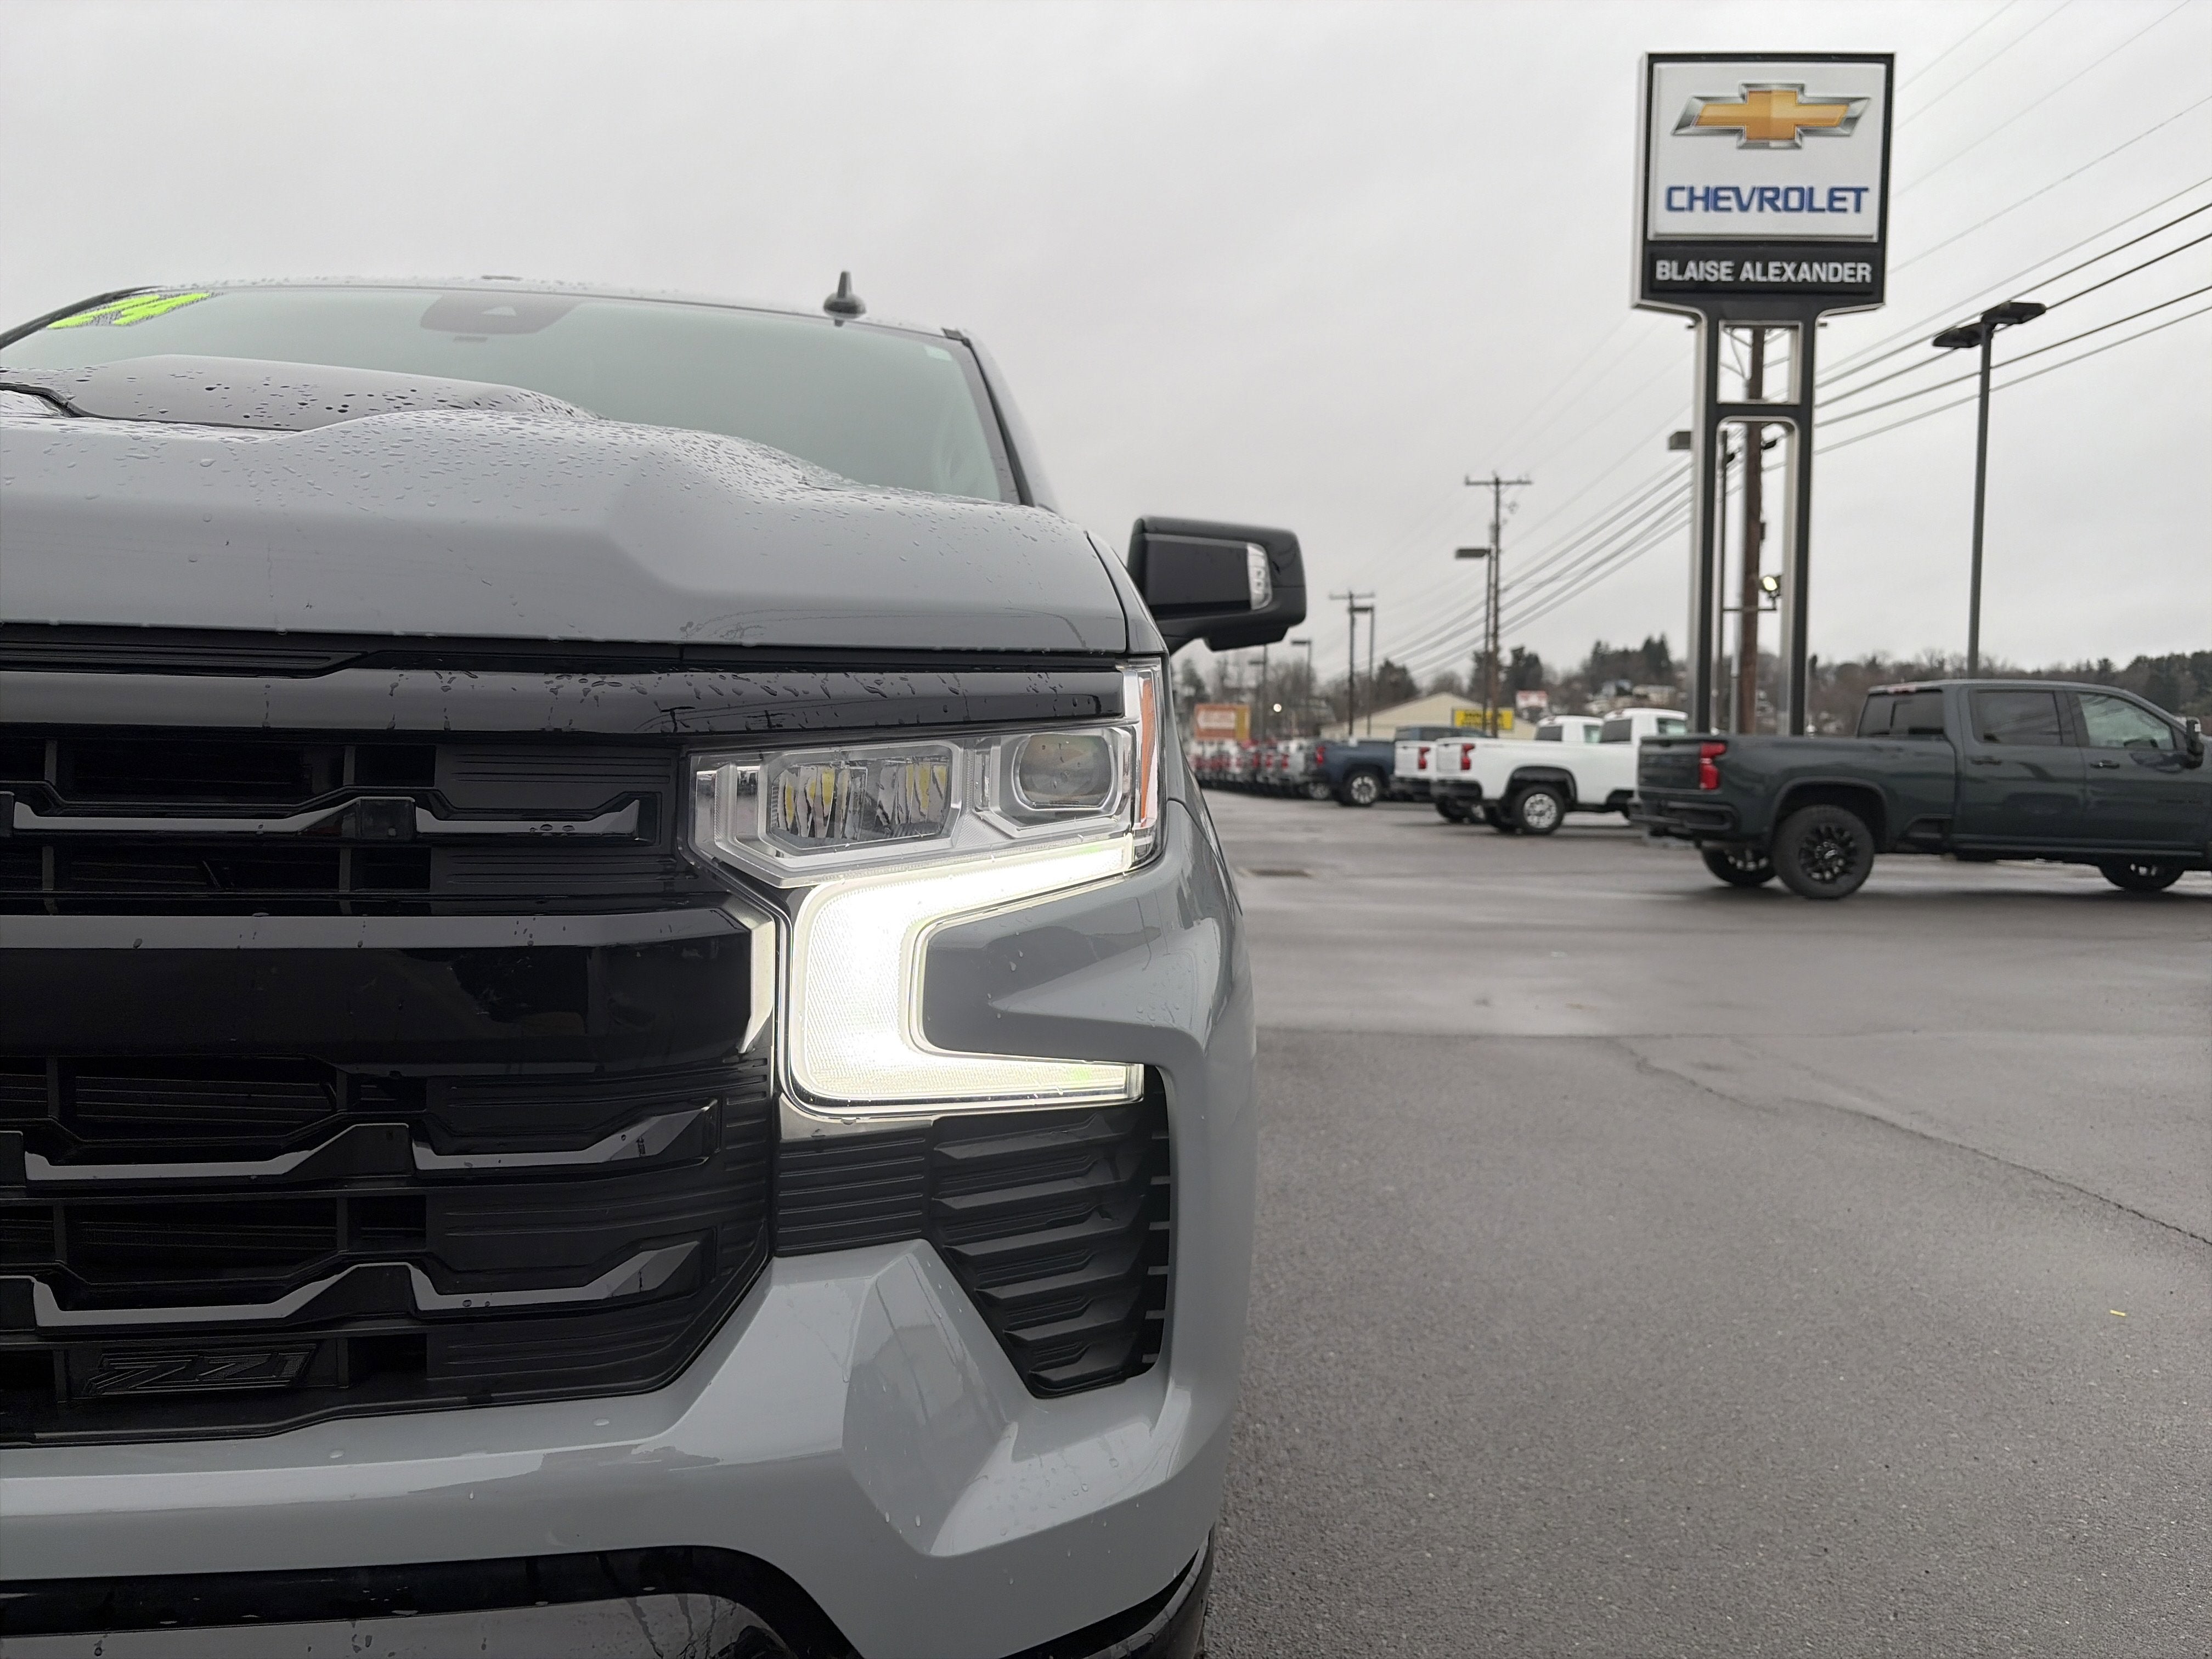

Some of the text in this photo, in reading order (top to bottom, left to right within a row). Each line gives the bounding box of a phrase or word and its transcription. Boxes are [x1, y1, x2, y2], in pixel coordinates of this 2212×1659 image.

[1666, 186, 1869, 213] CHEVROLET
[1655, 259, 1872, 283] BLAISE ALEXANDER
